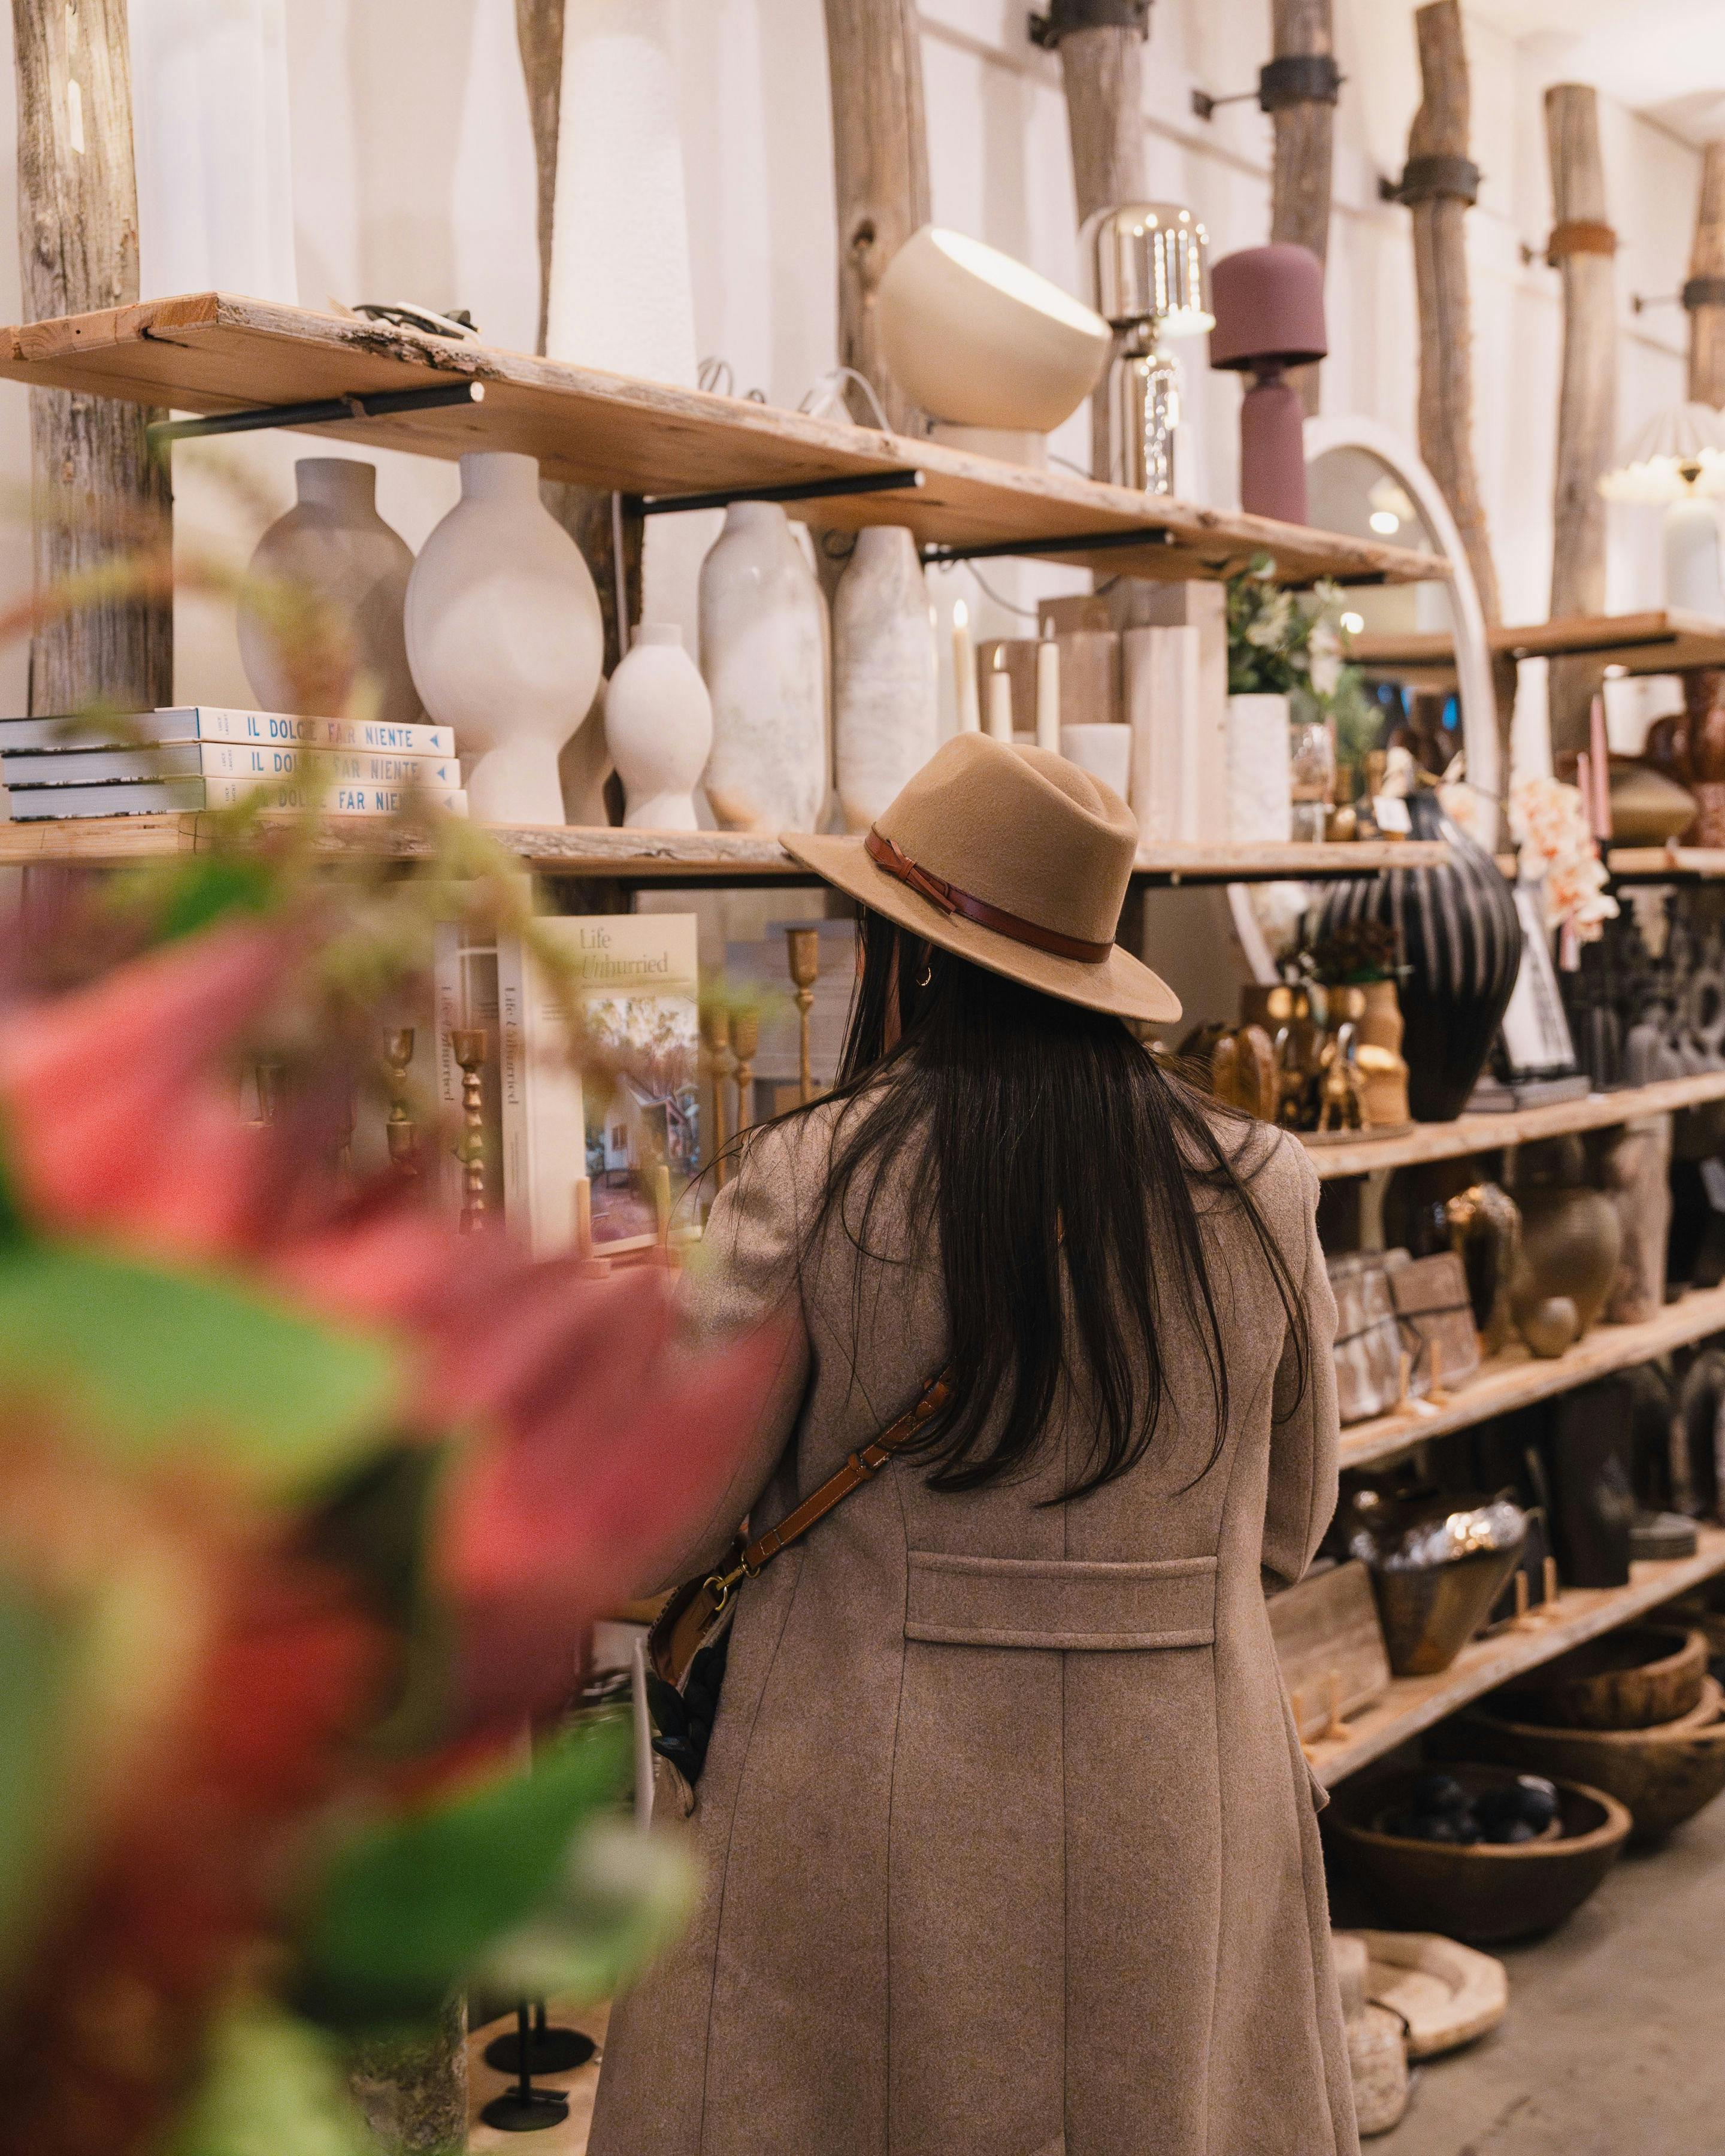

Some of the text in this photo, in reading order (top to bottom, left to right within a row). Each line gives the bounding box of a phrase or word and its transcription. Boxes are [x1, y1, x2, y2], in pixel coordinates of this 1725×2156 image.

[247, 716, 260, 737] IL
[365, 726, 413, 747] NIENTE
[252, 751, 264, 771] IL
[371, 759, 419, 781] NIENTE
[338, 791, 365, 810] FAR
[580, 928, 612, 949] Life
[582, 951, 668, 979] Unhurried
